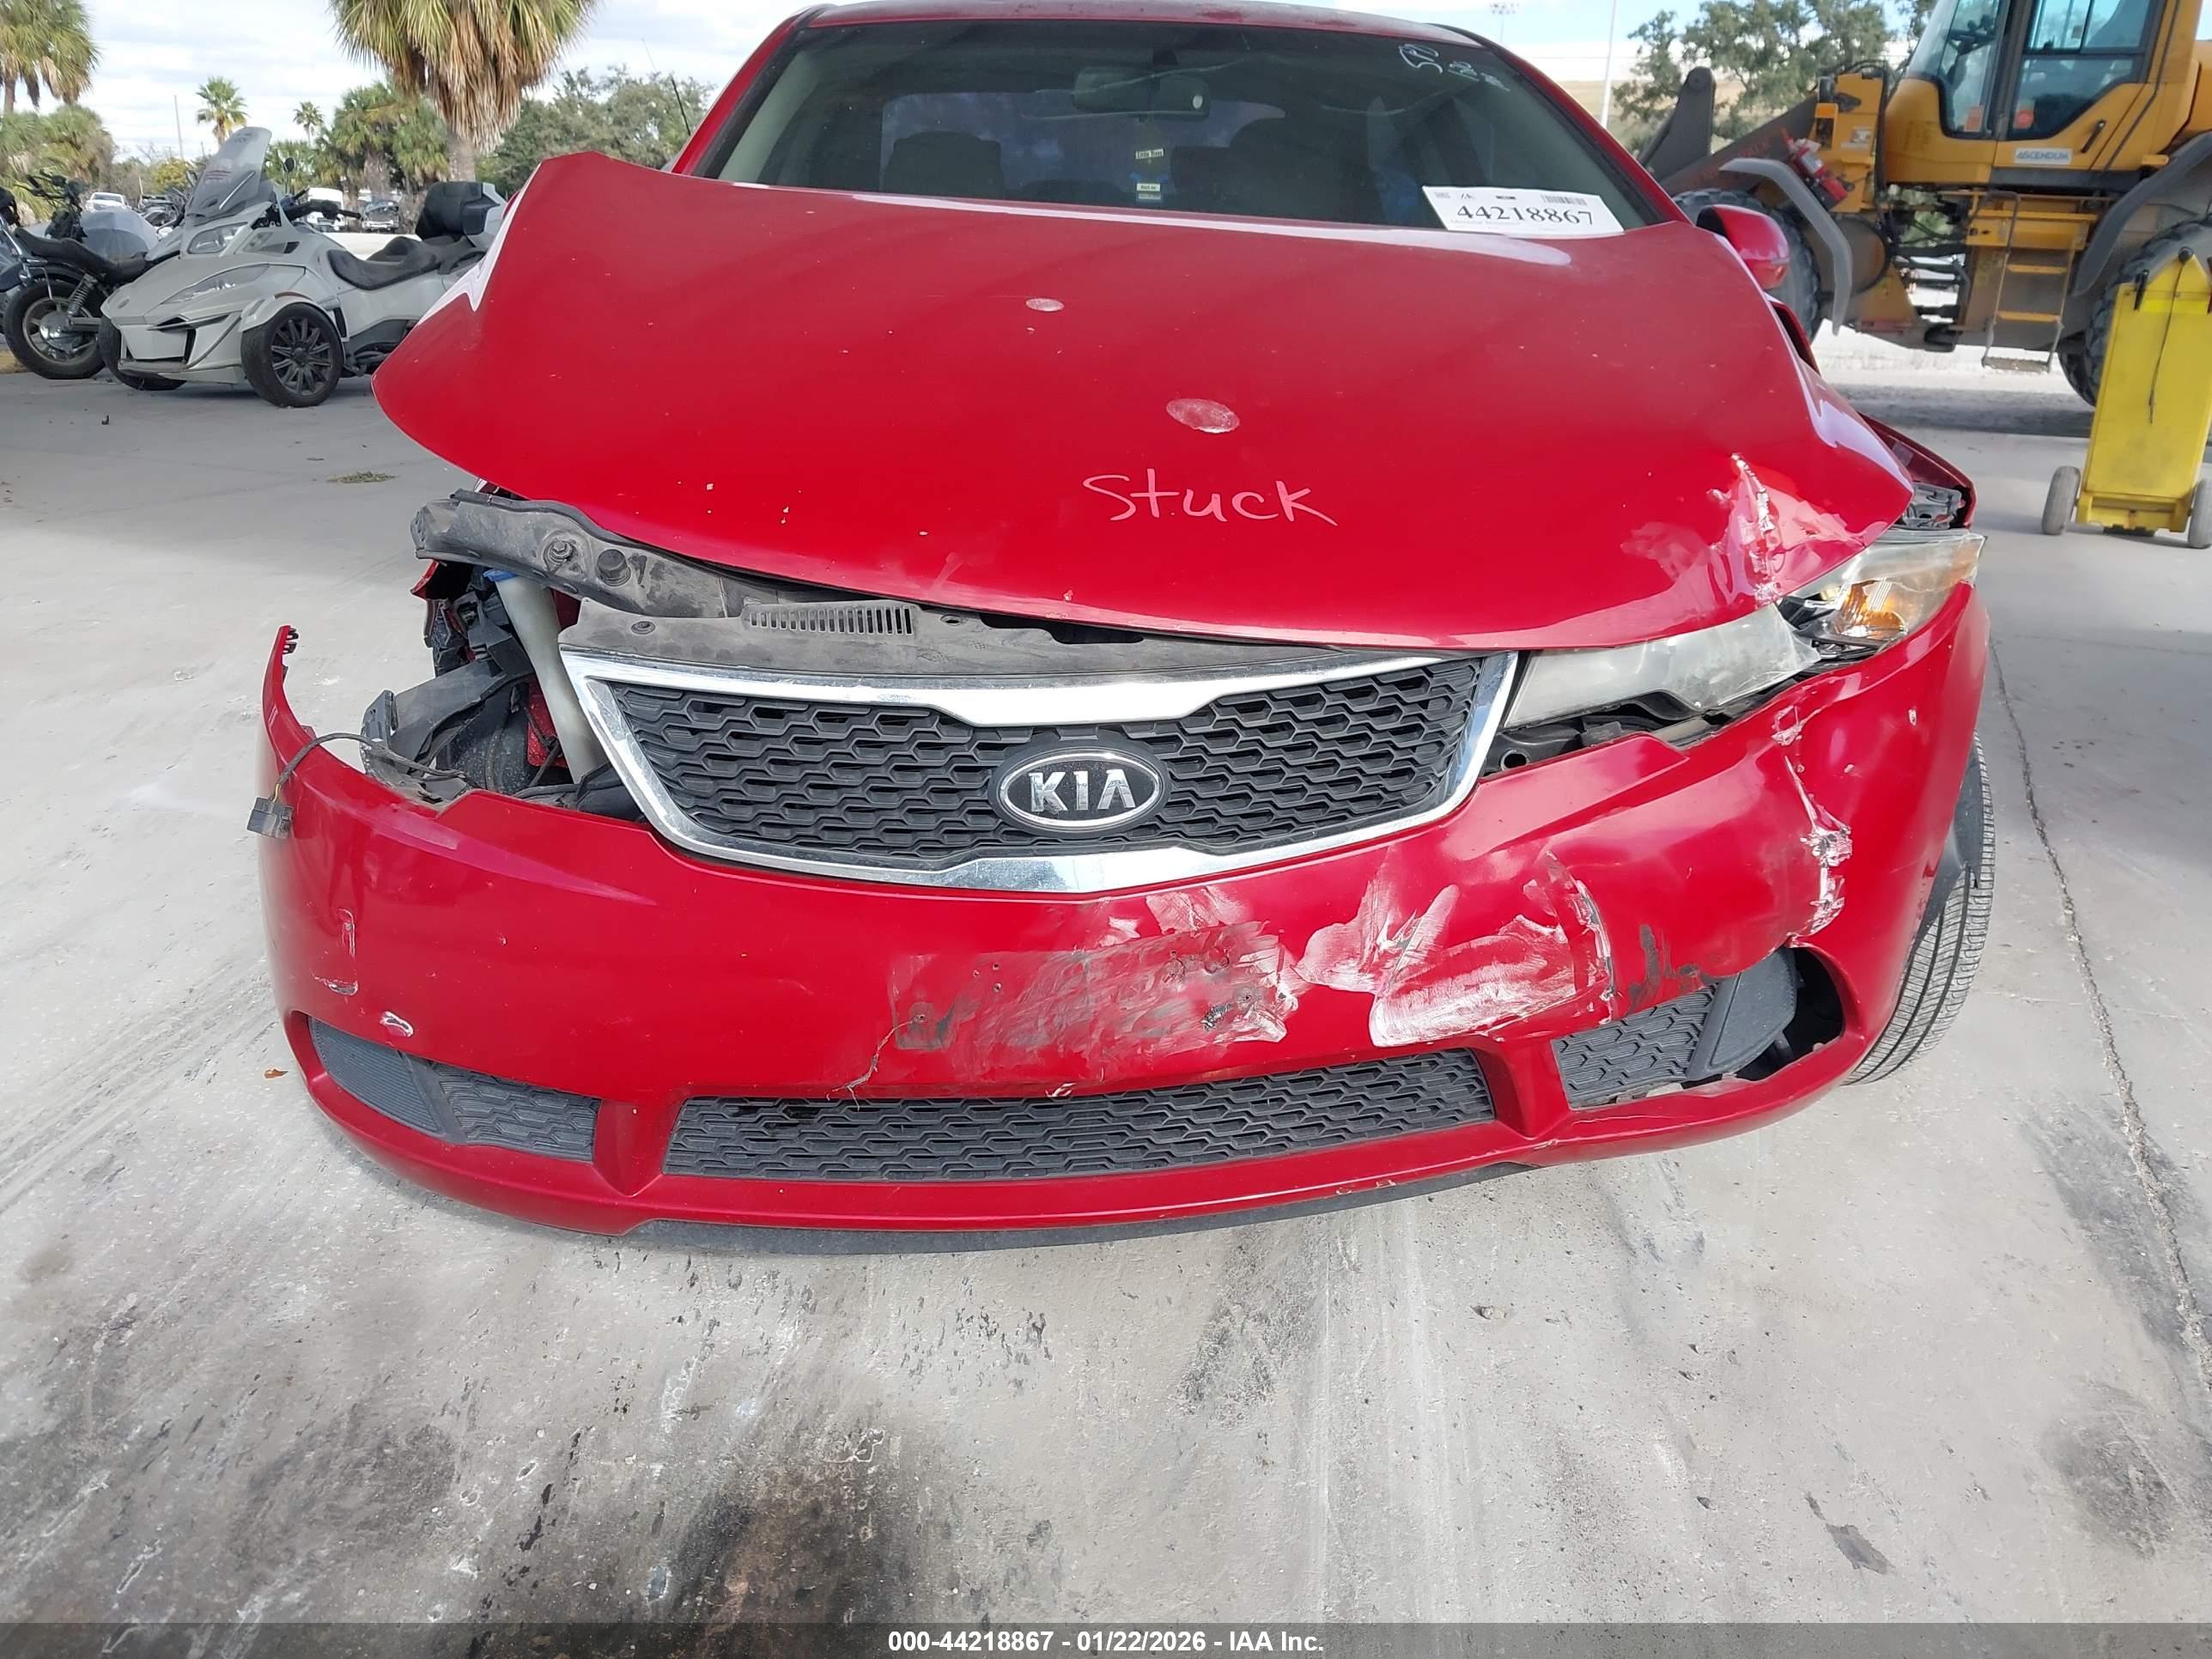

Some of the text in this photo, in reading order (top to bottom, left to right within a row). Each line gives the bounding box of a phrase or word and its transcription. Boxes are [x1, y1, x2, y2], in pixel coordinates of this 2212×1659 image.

[1457, 205, 1593, 226] 44218867
[1082, 468, 1339, 526] Stuck
[1028, 769, 1136, 813] KIA
